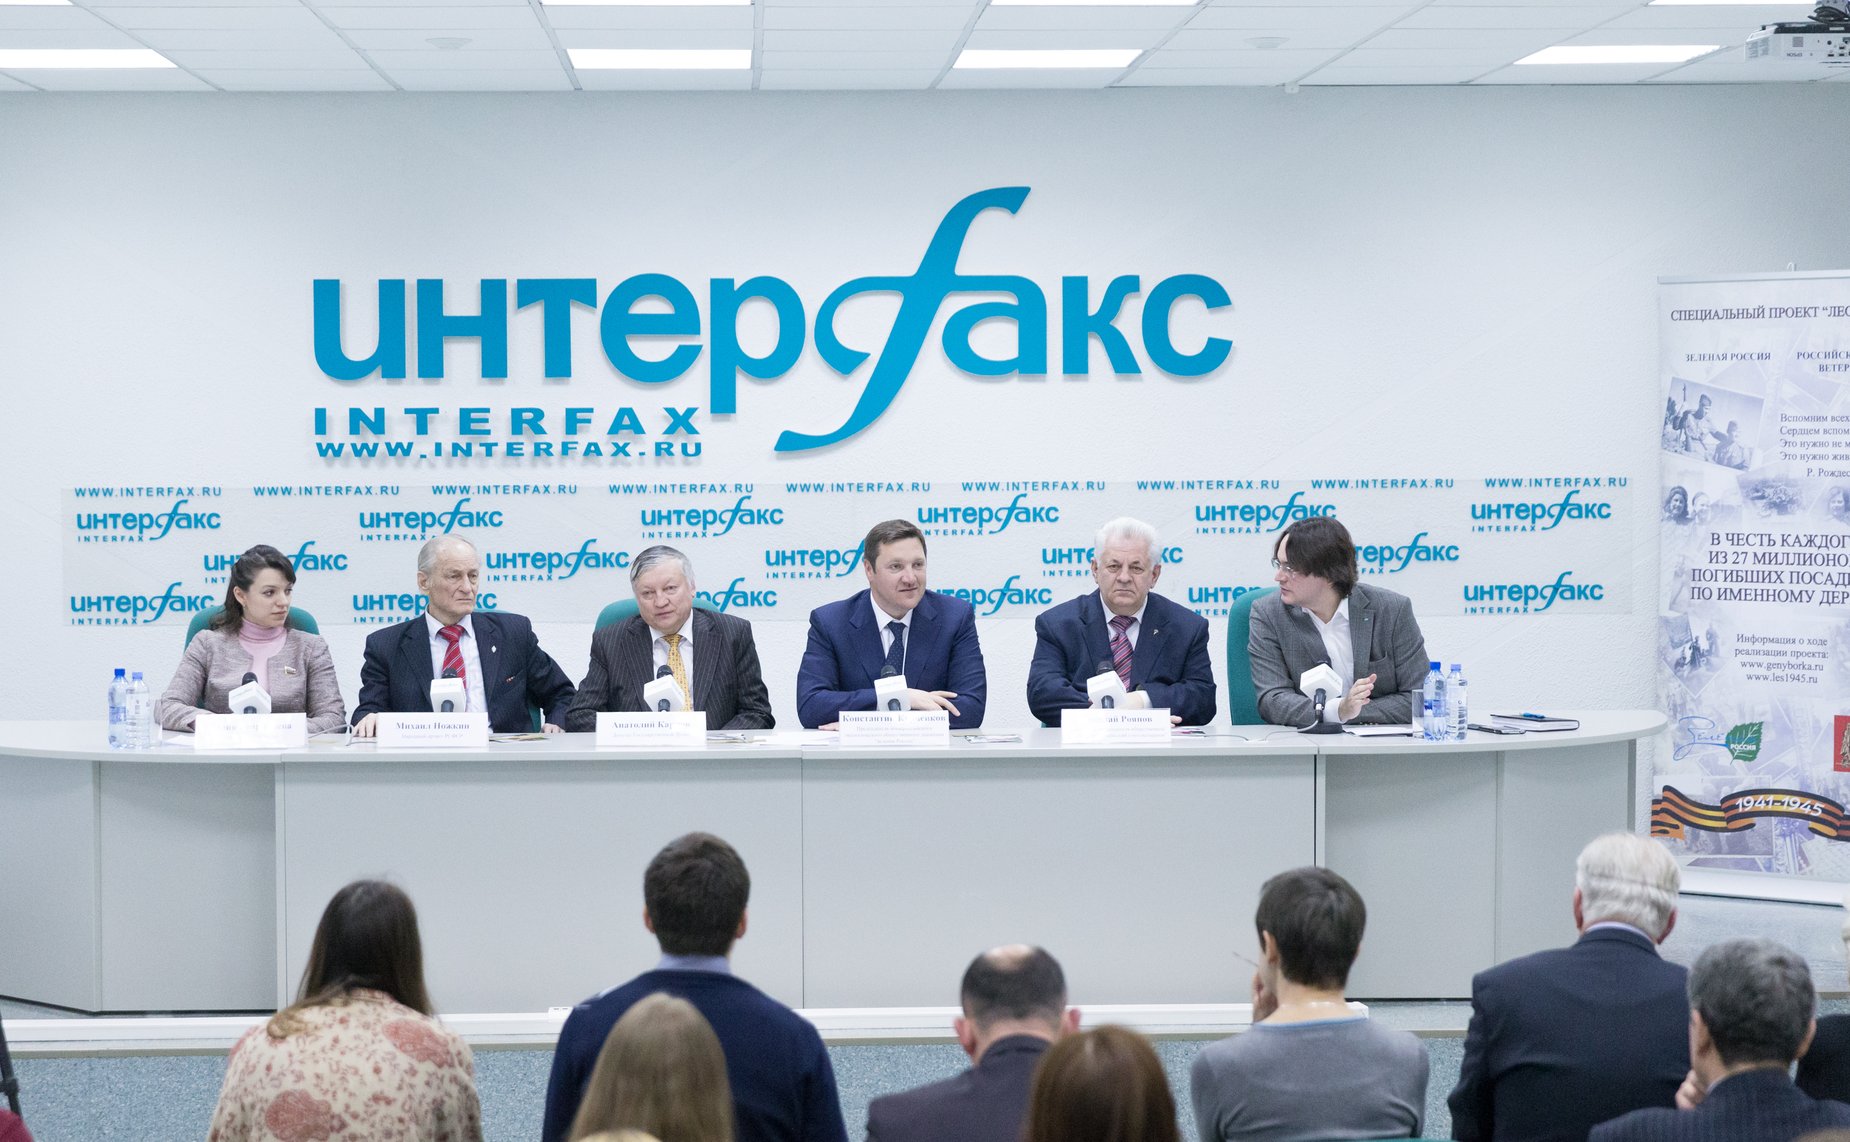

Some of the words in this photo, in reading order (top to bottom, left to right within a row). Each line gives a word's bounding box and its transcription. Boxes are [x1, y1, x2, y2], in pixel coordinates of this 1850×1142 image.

[1670, 305, 1766, 322] СПЕЦИАЛЬНЫЙ
[1769, 306, 1819, 320] ПРОЕКТ
[1685, 353, 1727, 361] ЗЕЛЕНАЯ
[1730, 352, 1771, 361] РОССИЯ
[1818, 363, 1850, 372] ВЕТЕР
[314, 407, 702, 436] INTERFAX
[1780, 413, 1828, 422] Вспомним
[1780, 426, 1820, 437] Сердцем
[1780, 438, 1797, 448] Это
[1800, 440, 1830, 450] нужно
[316, 441, 703, 458] WWW.INTERFAX.RU
[1780, 451, 1797, 460] Это
[1800, 453, 1830, 463] нужно
[1807, 467, 1816, 477] Р.
[786, 482, 930, 493] WWW.INTERFAX.RU
[962, 480, 1105, 491] WWW.INTERFAX.RU
[1137, 480, 1279, 490] WWW.INTERFAX.RU
[1312, 479, 1454, 489] WWW.INTERFAX.RU
[1485, 478, 1626, 487] WWW.INTERFAX.RU
[75, 487, 222, 497] WWW.INTERFAX.RU
[254, 486, 399, 496] WWW.INTERFAX.RU
[432, 484, 576, 495] WWW.INTERFAX.RU
[609, 483, 754, 493] WWW.INTERFAX.RU
[924, 528, 983, 536] NTERFAX
[1197, 526, 1260, 534] INTERFAX
[1472, 524, 1535, 532] INTERFAX
[78, 534, 143, 542] INTERFAX
[361, 533, 426, 541] INTERFAX
[642, 531, 707, 539] INTERFAX
[1711, 532, 1721, 546] В
[1725, 532, 1776, 547] ЧЕСТЬ
[1708, 550, 1728, 564] ИЗ
[1732, 551, 1748, 564] 27
[1752, 552, 1850, 567] МИЛЛИОНО
[487, 574, 552, 582] INTERFAX
[766, 571, 830, 579] INTERFAX
[1691, 568, 1784, 584] ПОГИБШИХ
[1789, 570, 1850, 588] ПОСАД
[1690, 586, 1713, 600] ПО
[1717, 588, 1815, 603] ИМЕННОМУ
[1819, 590, 1850, 606] ДЕР
[1465, 606, 1528, 614] INTERFAX
[72, 617, 137, 625] INTERFAX
[354, 616, 412, 625] INTERFA
[1736, 633, 1796, 646] Информация
[1734, 648, 1787, 658] реализации
[1790, 649, 1829, 660] проекта:
[1740, 660, 1824, 672] www.genyborka.ru
[1746, 672, 1818, 684] www.les1945.ru
[1735, 795, 1825, 817] 1941-1945
